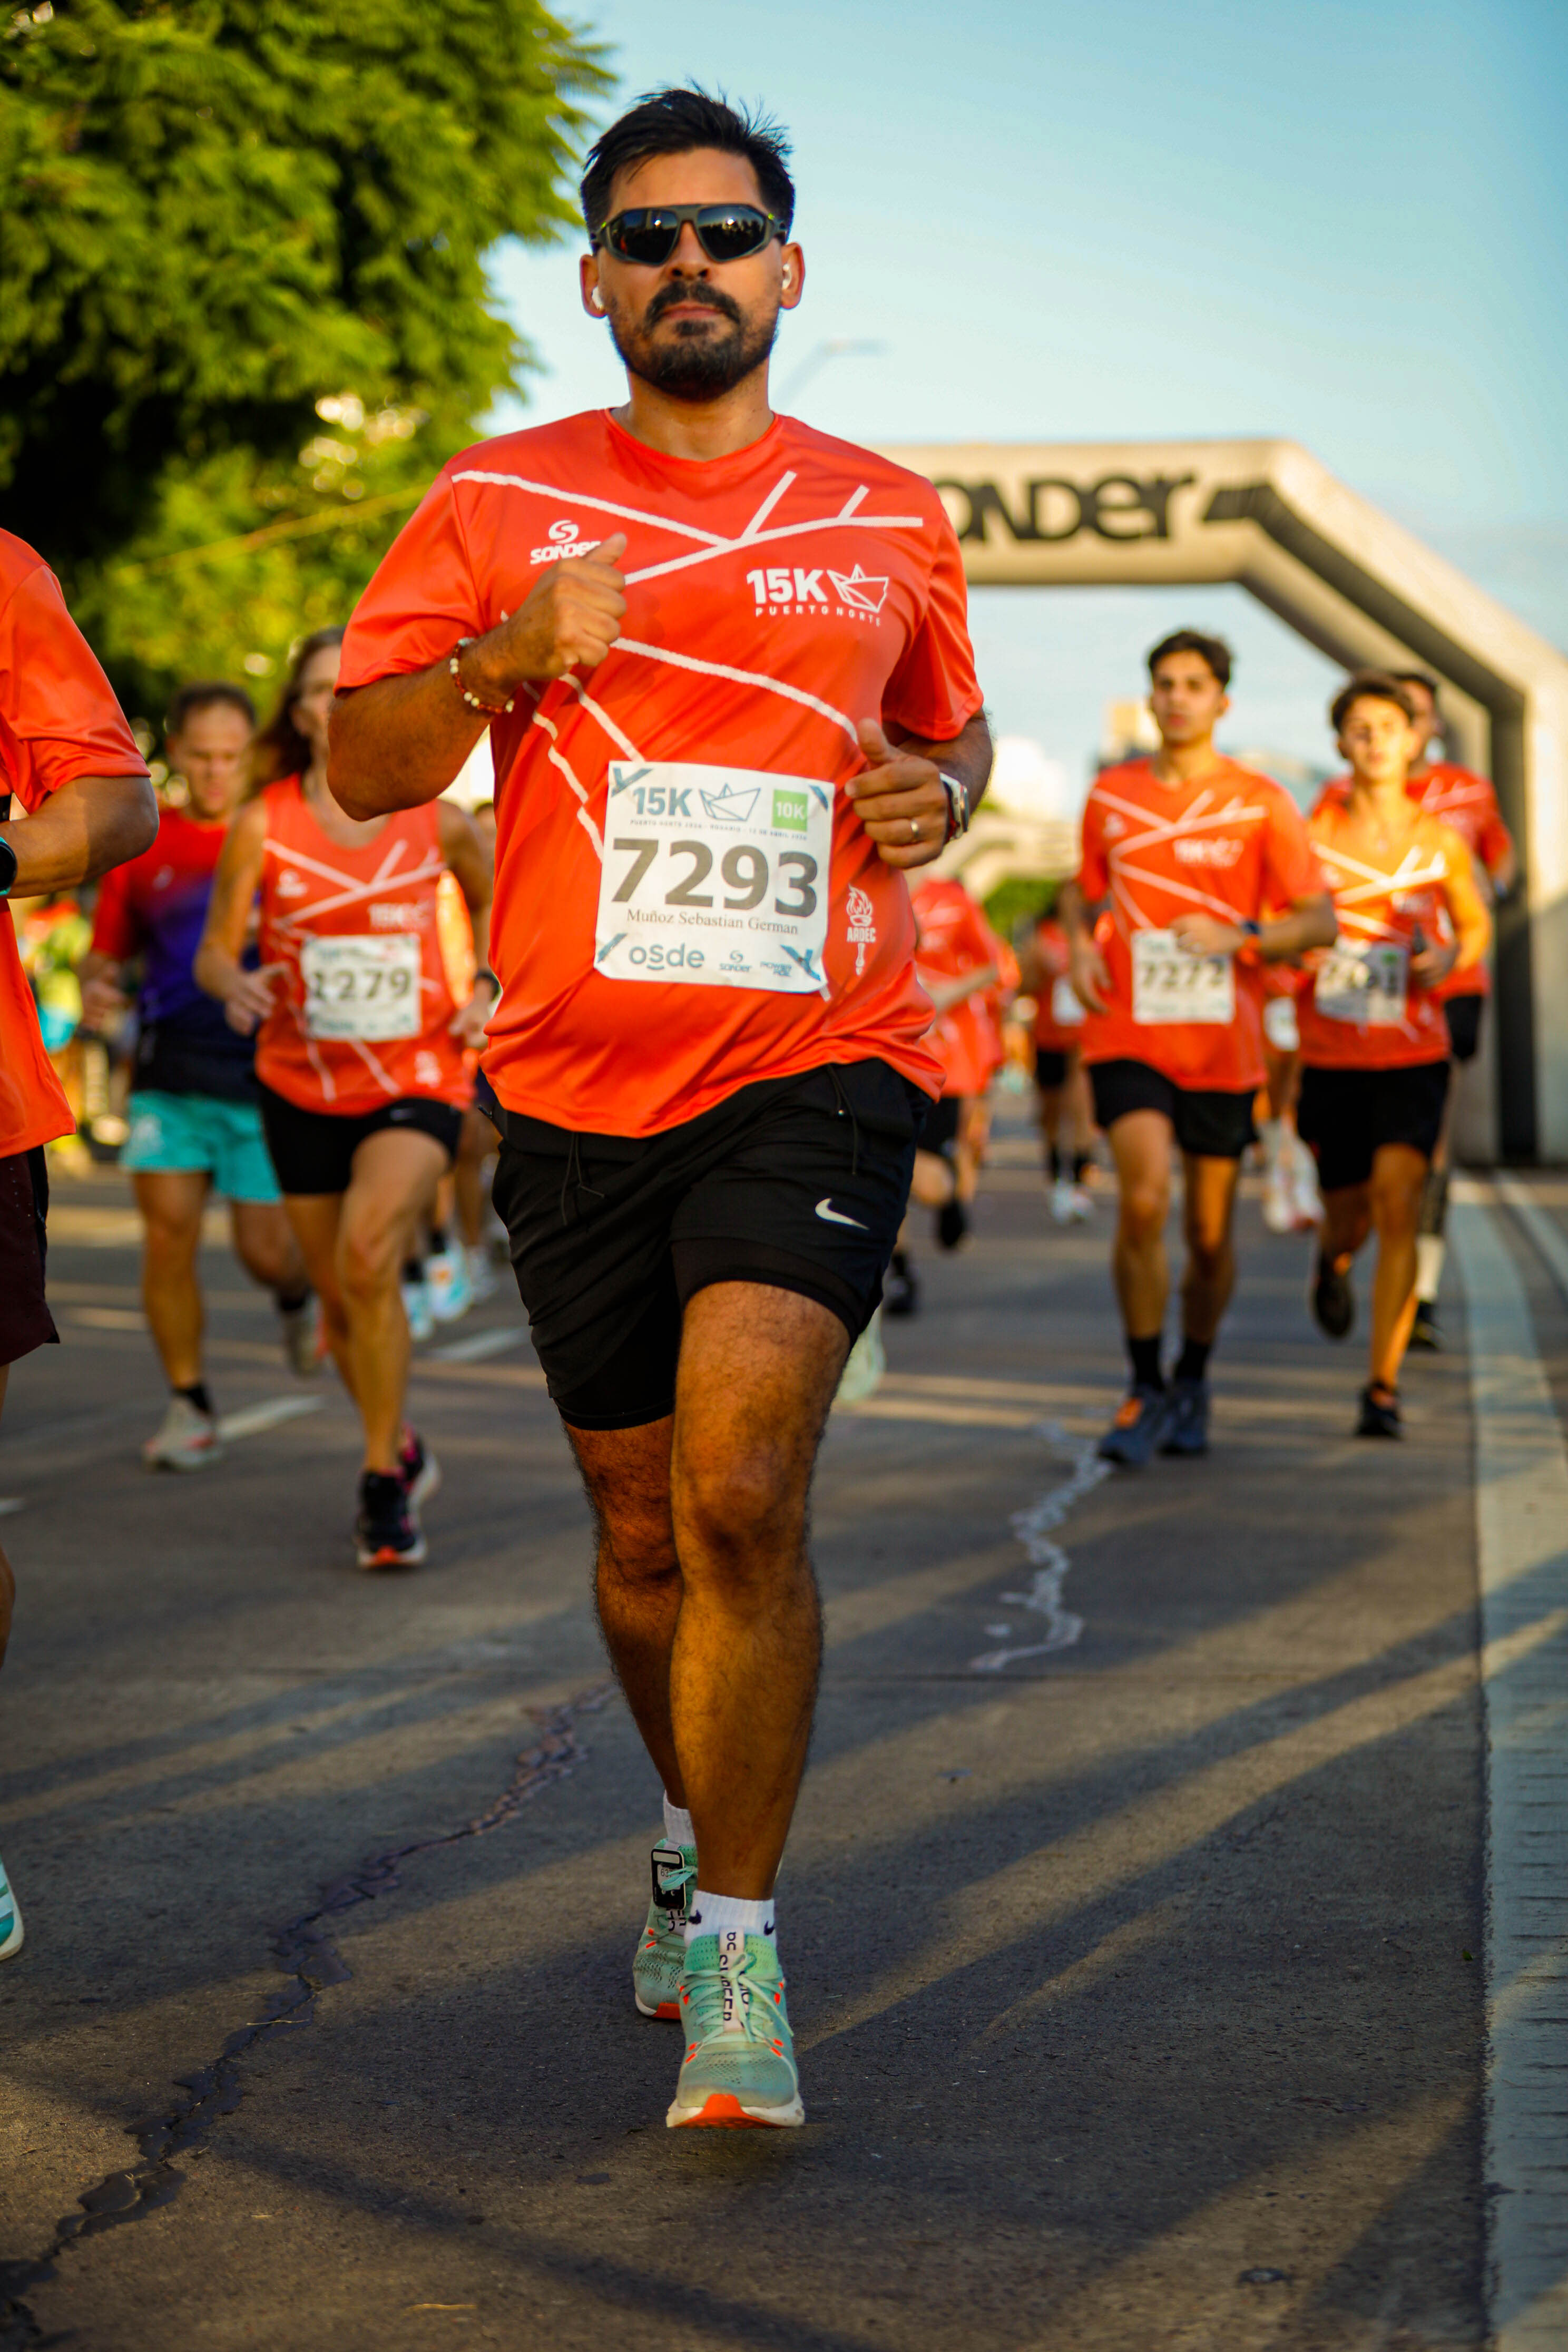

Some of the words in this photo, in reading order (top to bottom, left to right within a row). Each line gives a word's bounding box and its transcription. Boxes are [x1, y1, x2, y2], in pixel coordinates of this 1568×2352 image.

[932, 471, 1196, 542] ONDer
[746, 568, 828, 604] 15K
[756, 605, 829, 617] PUERTO
[836, 607, 880, 627] NORTE
[632, 787, 693, 817] 15K
[775, 800, 806, 820] 10K
[611, 838, 818, 918] 7293
[626, 908, 674, 924] Muñoz
[678, 912, 743, 928] Sebastian
[748, 915, 798, 935] German
[629, 943, 704, 968] osde
